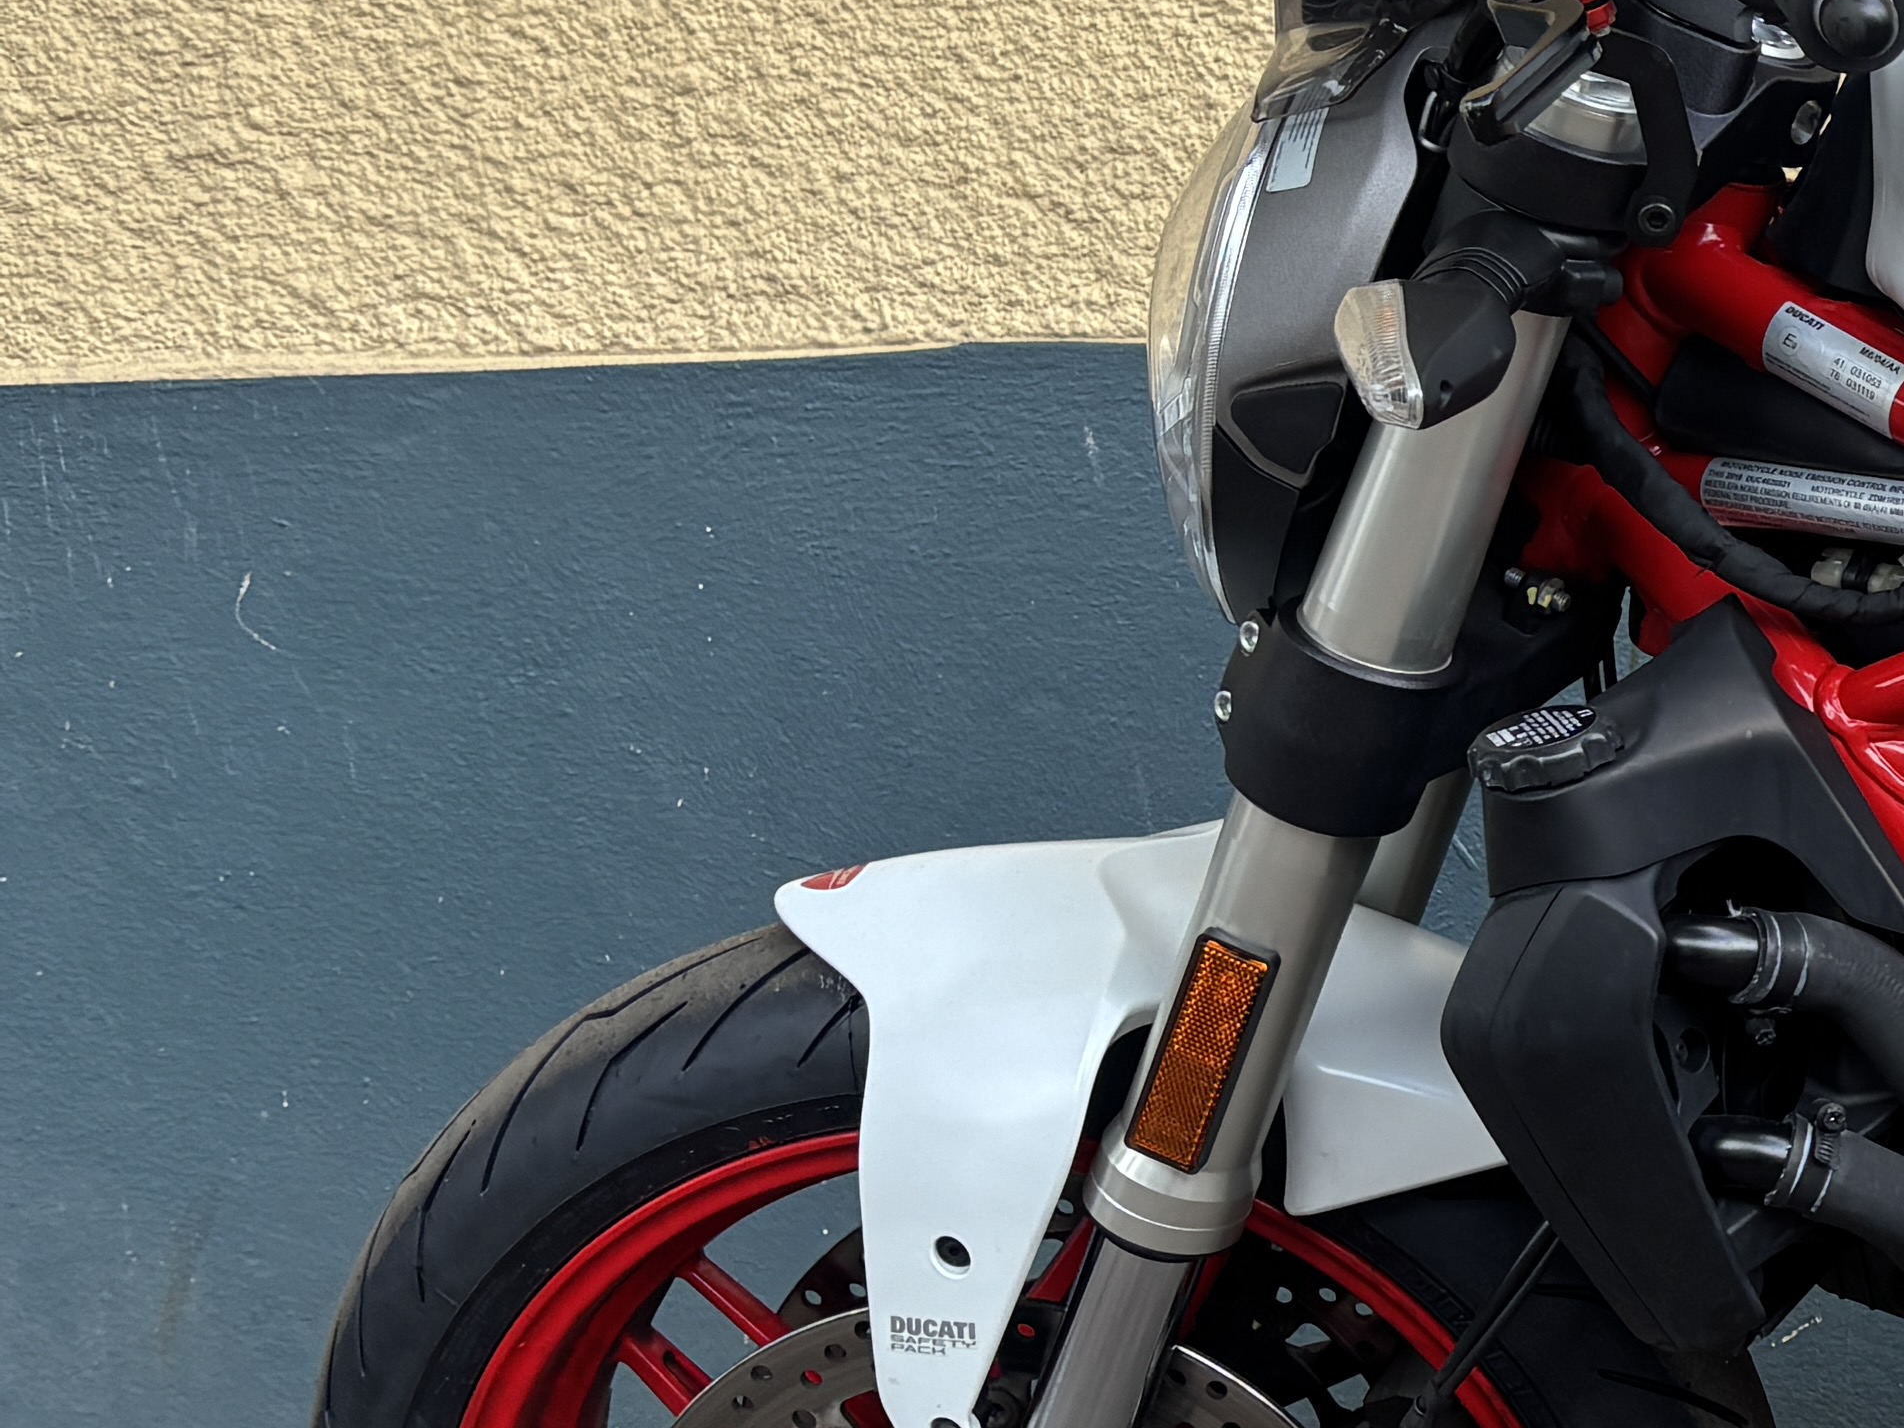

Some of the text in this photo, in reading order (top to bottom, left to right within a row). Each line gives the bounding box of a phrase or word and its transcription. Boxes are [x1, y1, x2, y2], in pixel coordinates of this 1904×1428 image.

[1785, 306, 1825, 330] DUCATI
[890, 1315, 976, 1340] DUCATI
[890, 1334, 977, 1349] SAFETY
[890, 1343, 947, 1356] PACK
